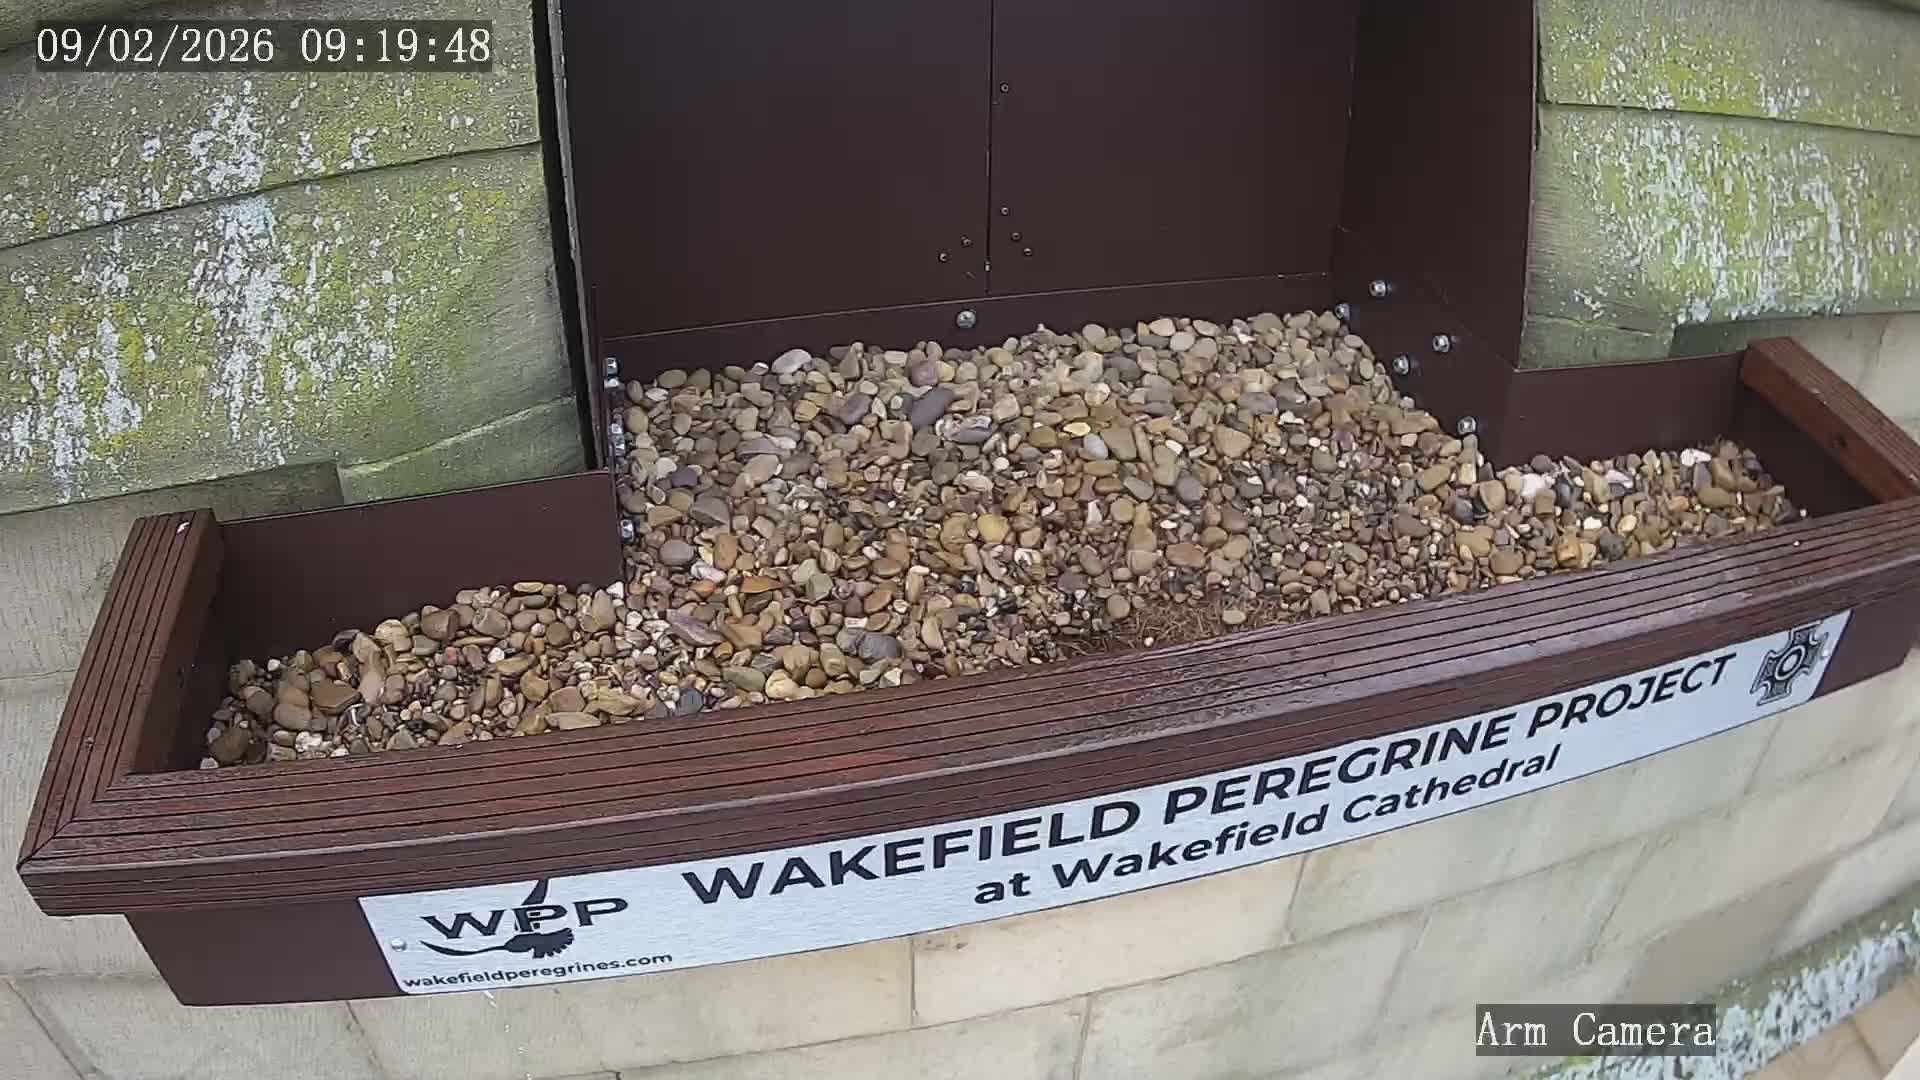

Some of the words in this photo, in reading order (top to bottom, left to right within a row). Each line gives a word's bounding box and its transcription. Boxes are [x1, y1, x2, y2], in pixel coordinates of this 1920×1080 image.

[682, 801, 1140, 904] WAKEFIELD
[1164, 713, 1517, 824] PEREGRINE
[1526, 653, 1736, 738] PROJECT
[974, 872, 1030, 904] at
[1052, 807, 1328, 888] Wakefield
[1343, 744, 1560, 823] Cathedral
[420, 898, 628, 939] WPP
[403, 952, 672, 987] wakefieldperegrines.com
